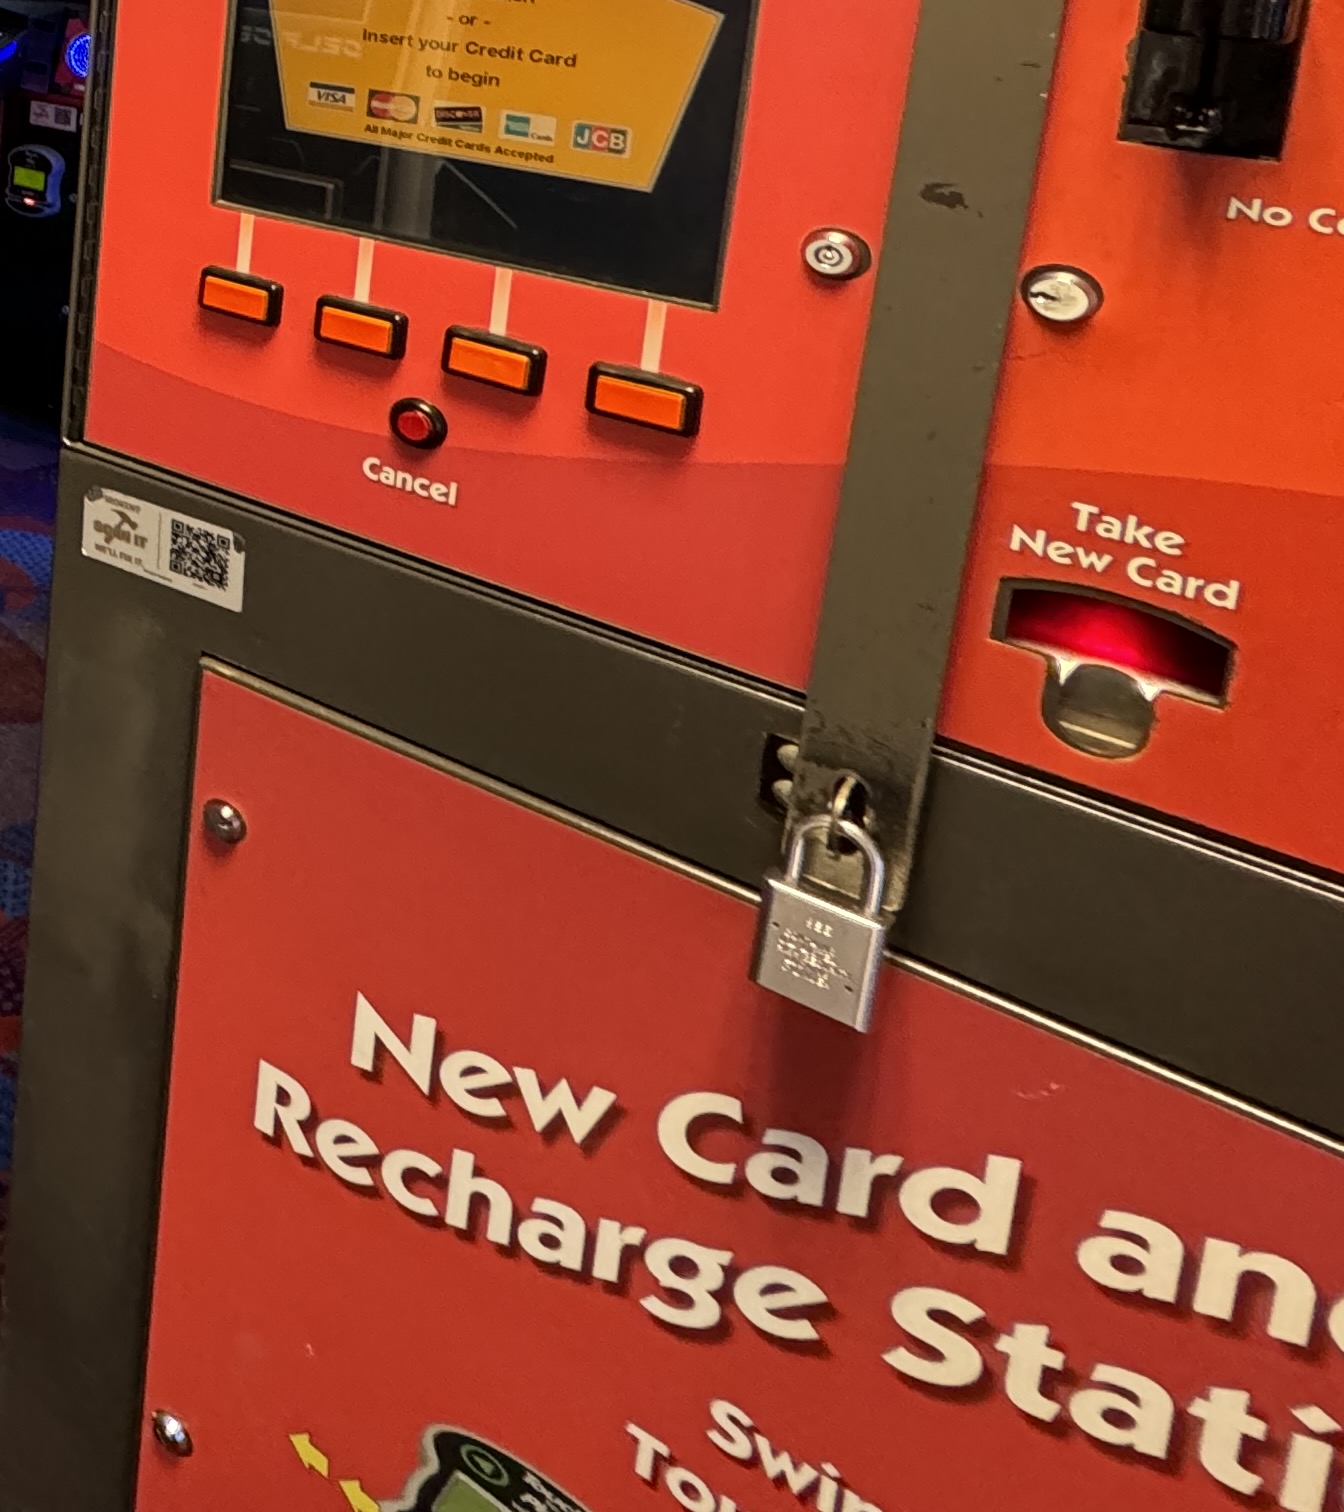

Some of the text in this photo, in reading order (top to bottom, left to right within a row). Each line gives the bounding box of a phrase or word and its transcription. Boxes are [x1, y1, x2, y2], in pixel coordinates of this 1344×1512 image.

[459, 13, 479, 29] or
[361, 28, 578, 69] Insert your Credit Card
[315, 89, 349, 106] VISA
[425, 64, 501, 90] to begin
[364, 122, 556, 165] All Major Credit Cards Accepted
[575, 127, 627, 155] JCB
[1226, 196, 1293, 227] No
[361, 456, 459, 507] Cancel
[1069, 500, 1186, 557] Take
[1009, 524, 1242, 612] New Card
[349, 988, 1344, 1351] New Card an
[251, 1056, 830, 1344] Recharge
